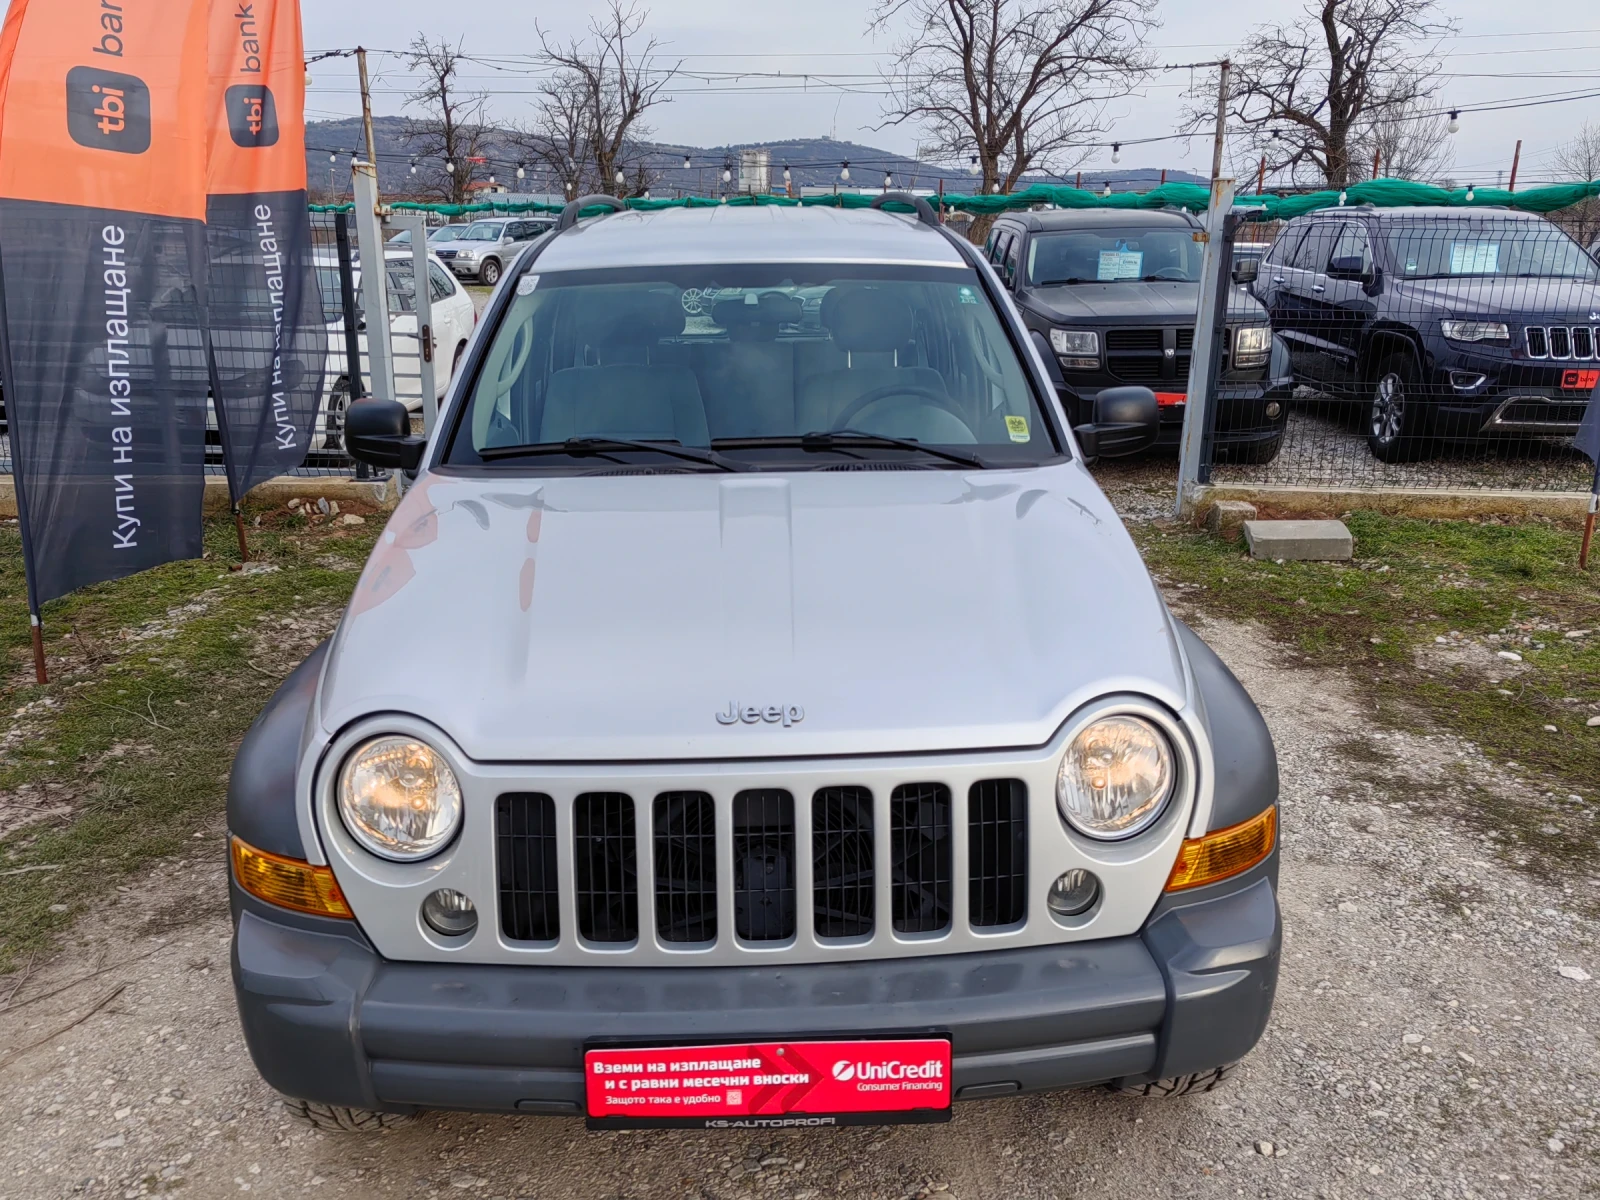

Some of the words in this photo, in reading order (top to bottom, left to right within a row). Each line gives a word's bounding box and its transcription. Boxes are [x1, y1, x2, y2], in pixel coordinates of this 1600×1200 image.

[234, 3, 261, 72] bank
[91, 84, 125, 135] tbi
[243, 97, 262, 135] tbi
[101, 225, 132, 415] изплащане
[272, 392, 297, 450] Купи
[111, 426, 133, 463] на
[112, 474, 141, 549] Купи
[715, 700, 805, 728] Jeep
[593, 1061, 643, 1074] Вземи
[647, 1062, 667, 1073] на
[670, 1058, 761, 1072] изплащане
[604, 1079, 615, 1090] и
[618, 1079, 628, 1089] с
[631, 1078, 679, 1091] равни
[683, 1075, 750, 1088] месечни
[753, 1073, 809, 1086] вноски
[857, 1060, 943, 1080] UniCredit
[605, 1095, 646, 1106] Защото
[649, 1095, 673, 1104] така
[673, 1096, 681, 1104] е
[683, 1093, 721, 1105] удобно
[857, 1082, 900, 1092] Consumer
[902, 1081, 943, 1092] Financing
[705, 1117, 836, 1128] KS-AUTOPROFI
